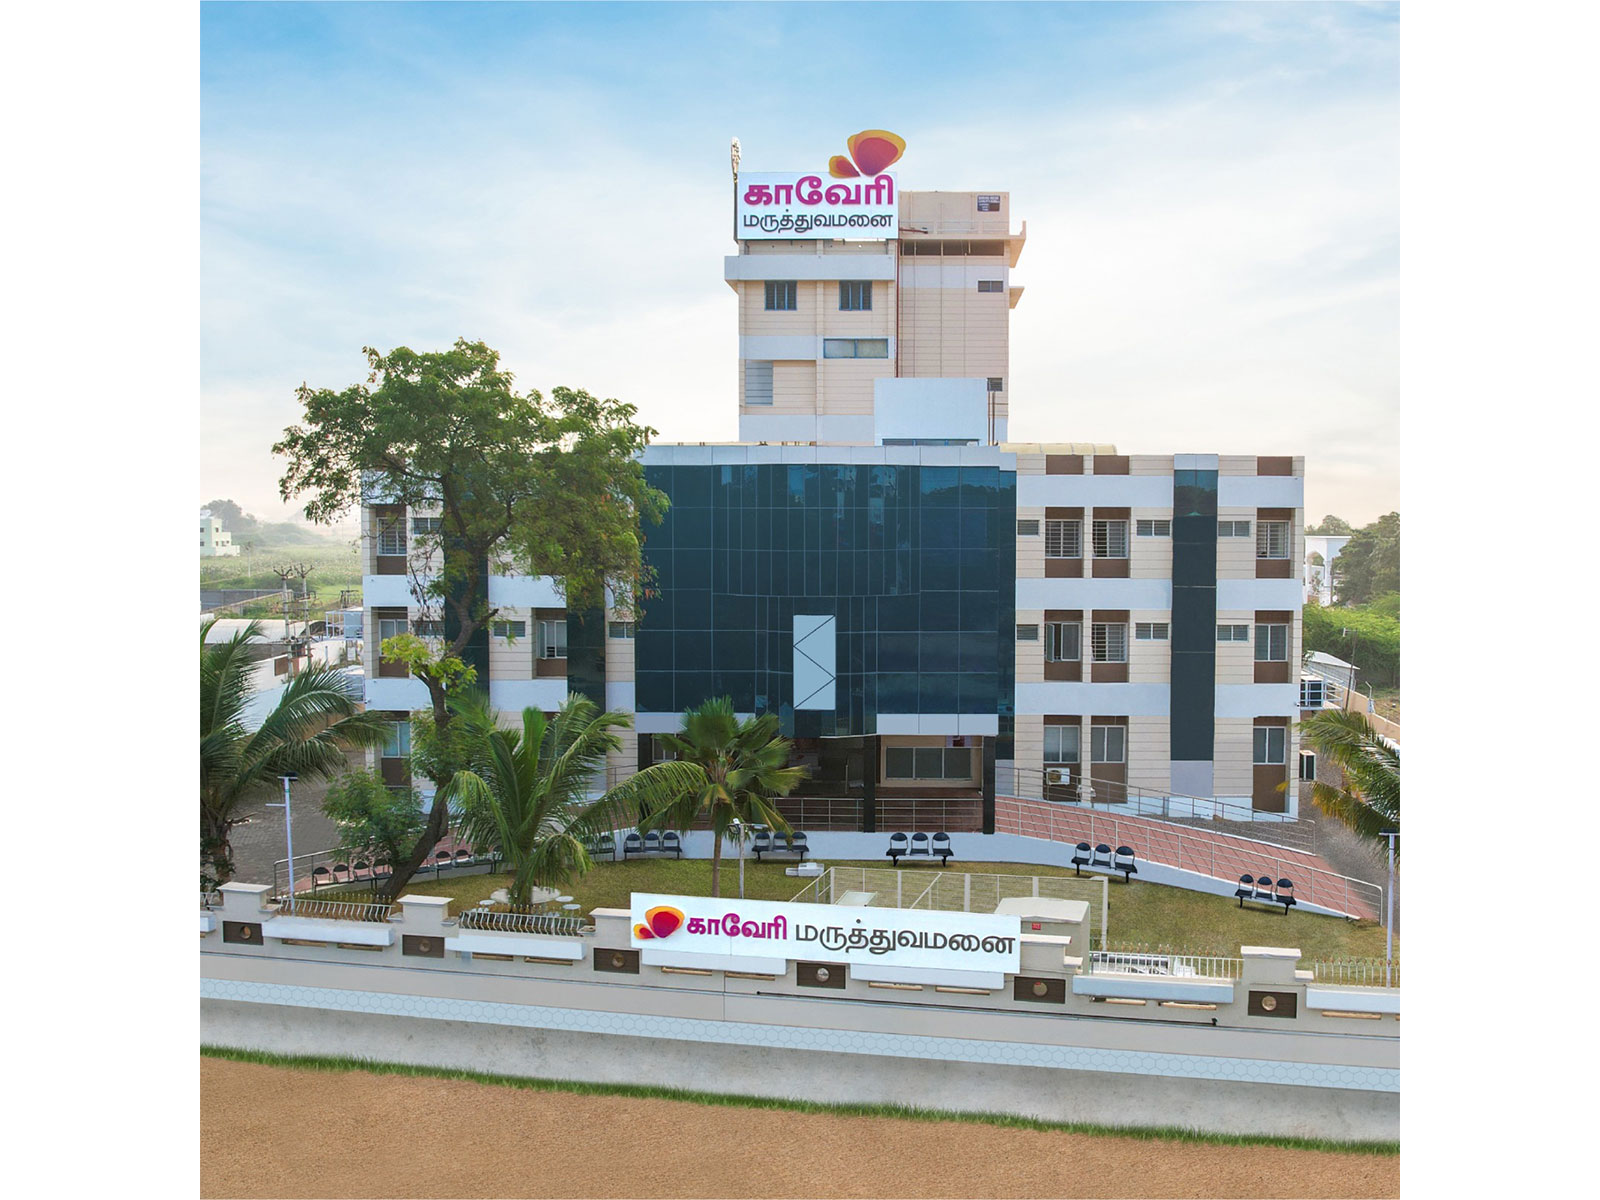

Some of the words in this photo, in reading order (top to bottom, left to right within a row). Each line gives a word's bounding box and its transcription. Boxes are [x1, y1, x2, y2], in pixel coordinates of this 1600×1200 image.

[743, 174, 894, 205] காவேரி
[743, 208, 894, 234] மருத்துவமனை
[686, 912, 788, 941] காவேரி
[795, 918, 1015, 955] மருத்துவமனை
